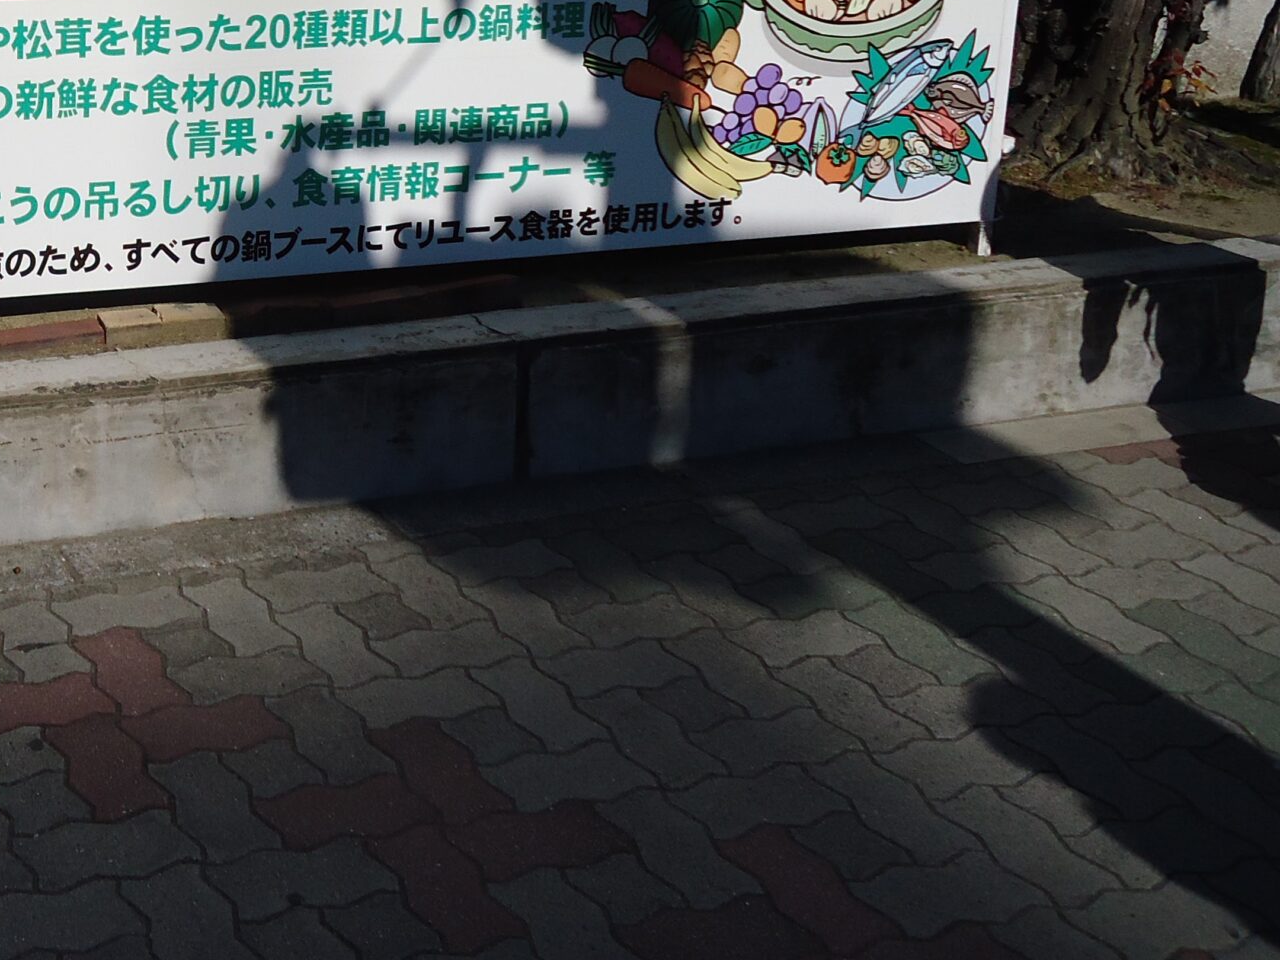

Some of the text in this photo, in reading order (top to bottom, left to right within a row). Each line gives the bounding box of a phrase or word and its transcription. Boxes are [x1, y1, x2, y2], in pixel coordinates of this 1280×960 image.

[165, 100, 570, 161] (青果・水産品・関連商品)
